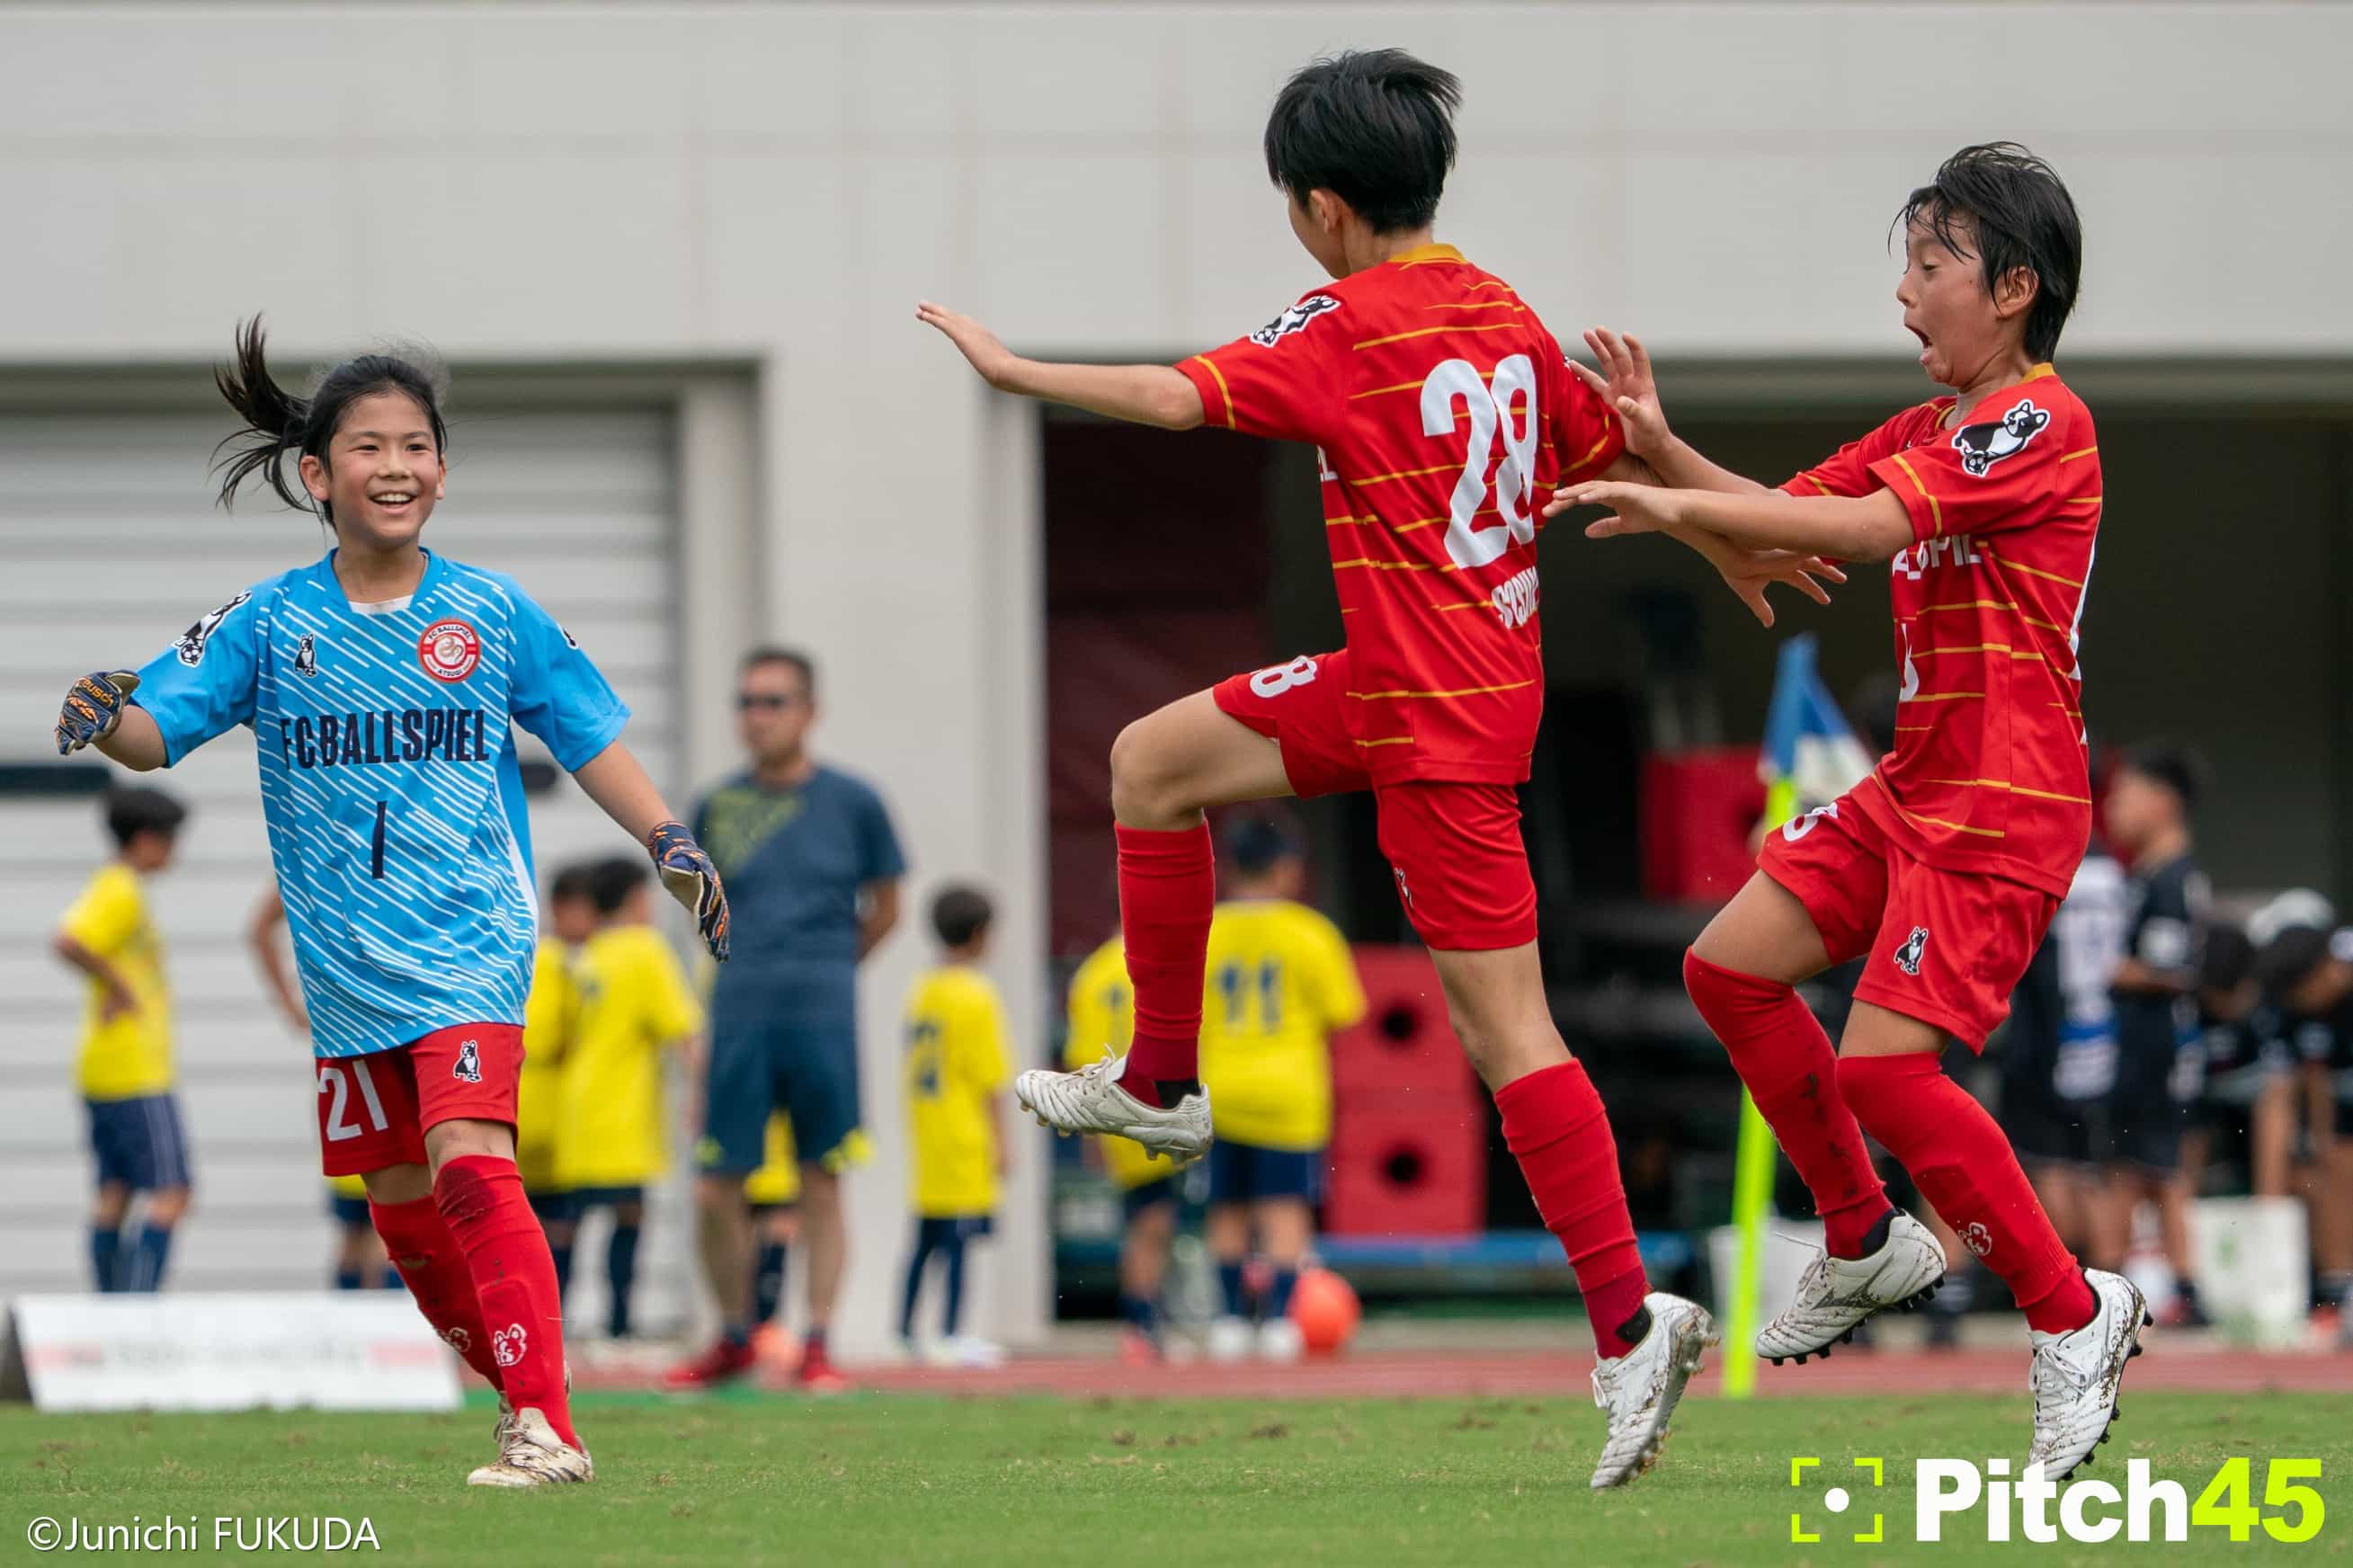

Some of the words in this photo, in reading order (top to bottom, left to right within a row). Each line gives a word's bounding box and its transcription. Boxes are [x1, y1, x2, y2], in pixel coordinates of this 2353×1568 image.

[1421, 353, 1537, 569] 28
[372, 800, 388, 880] 1
[318, 1059, 388, 1142] 21
